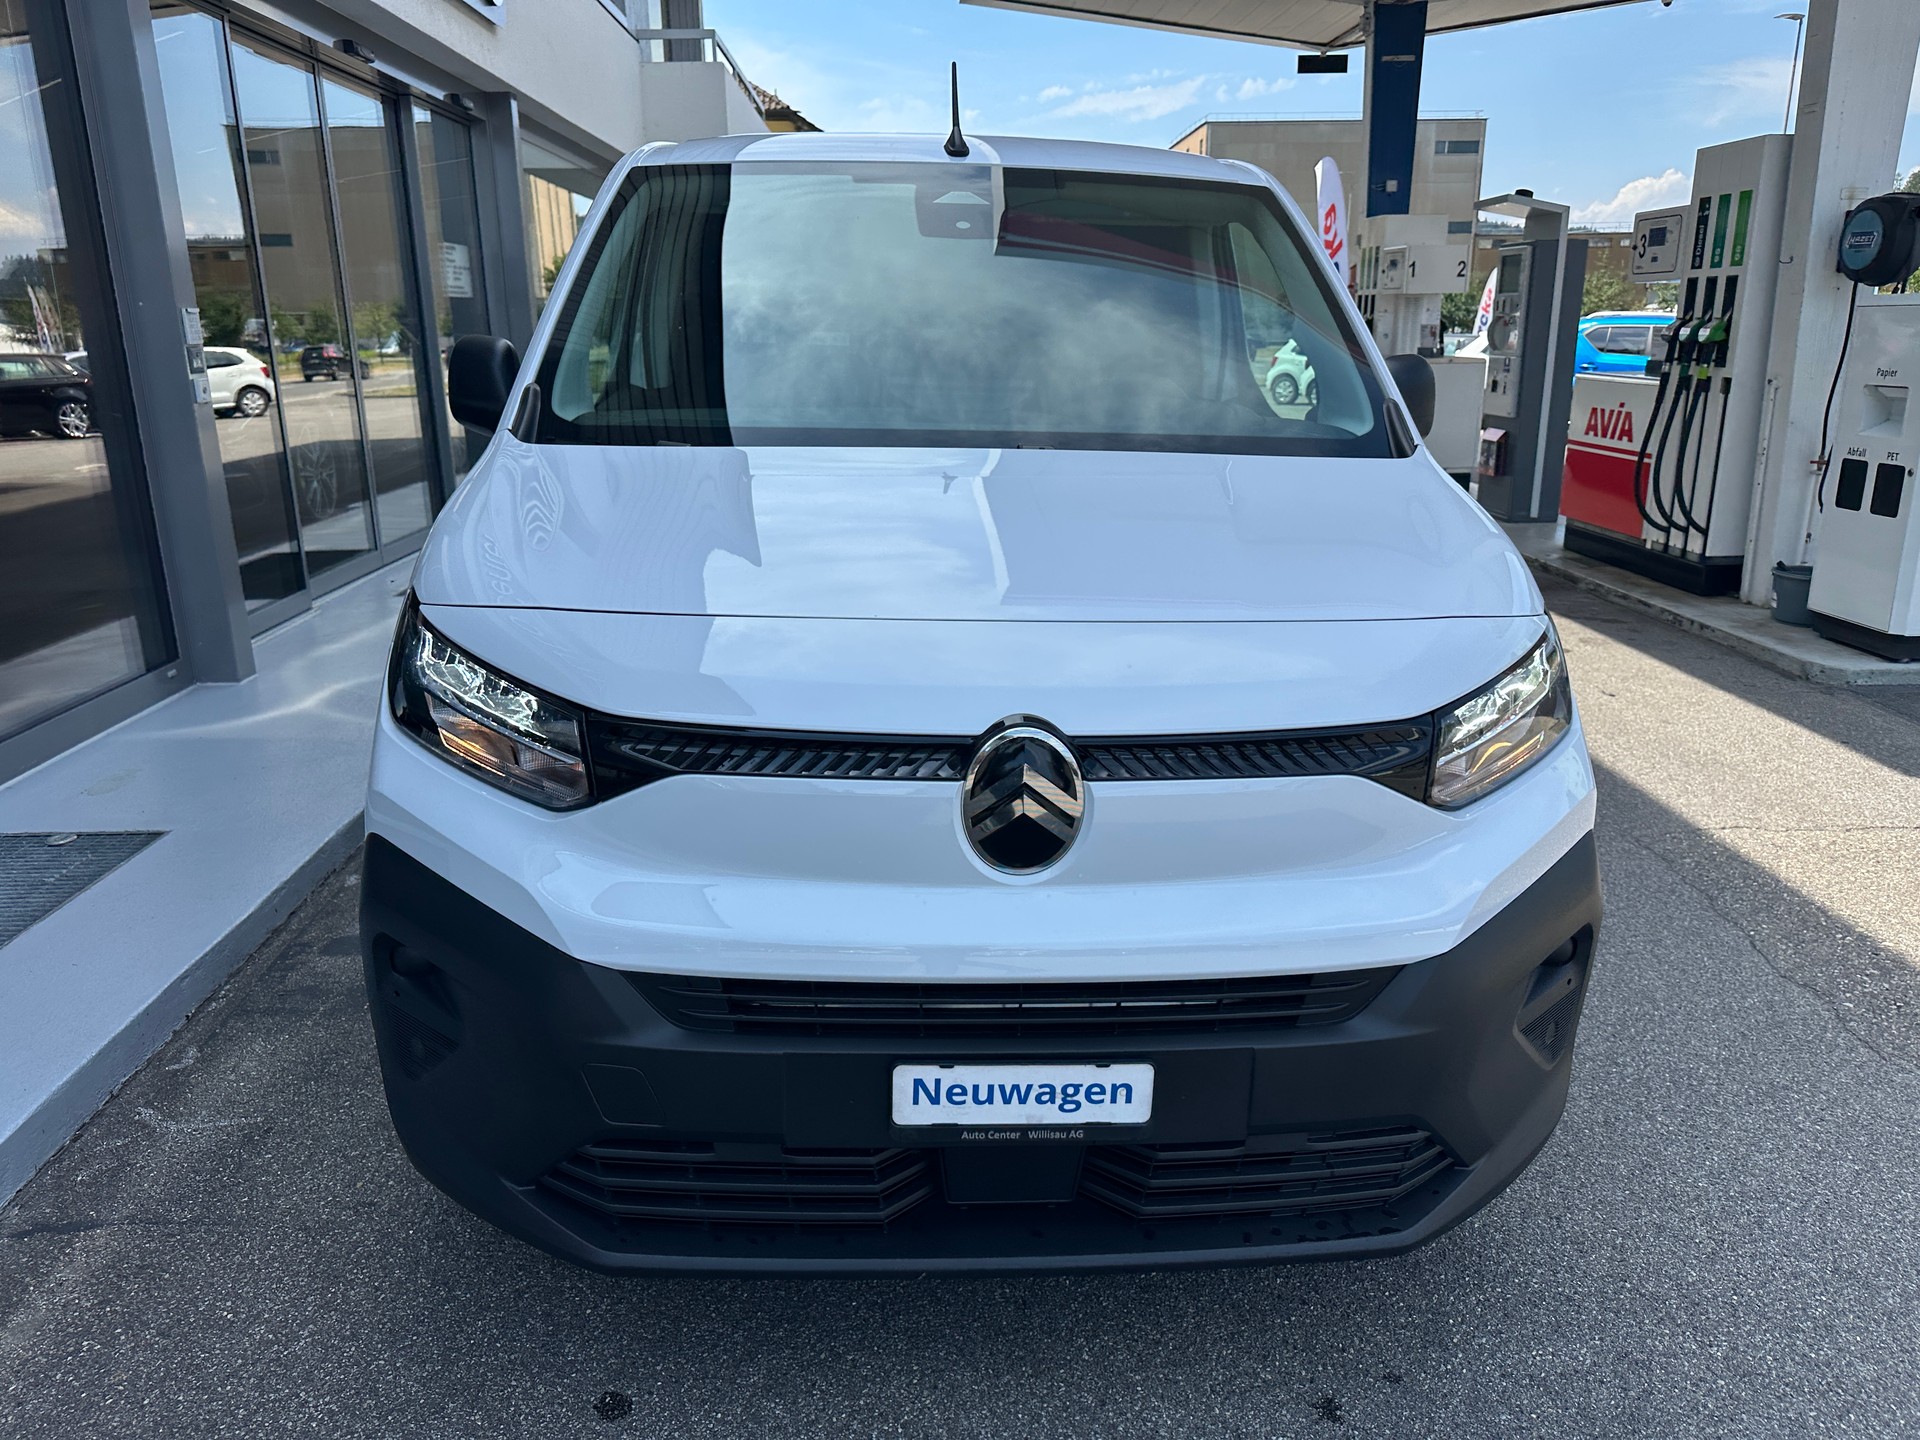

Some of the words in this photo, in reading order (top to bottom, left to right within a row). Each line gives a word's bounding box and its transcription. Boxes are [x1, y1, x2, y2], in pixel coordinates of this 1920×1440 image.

[1638, 234, 1647, 259] 3
[1408, 261, 1416, 278] 1
[1456, 260, 1467, 278] 2
[1876, 367, 1898, 380] Papier
[1846, 447, 1867, 458] Abfall
[1886, 451, 1900, 462] PET
[912, 1077, 1134, 1113] Neuwagen
[961, 1130, 986, 1140] Auto
[987, 1130, 1021, 1140] Center
[1028, 1130, 1067, 1139] Willisau
[1068, 1129, 1084, 1139] AG
